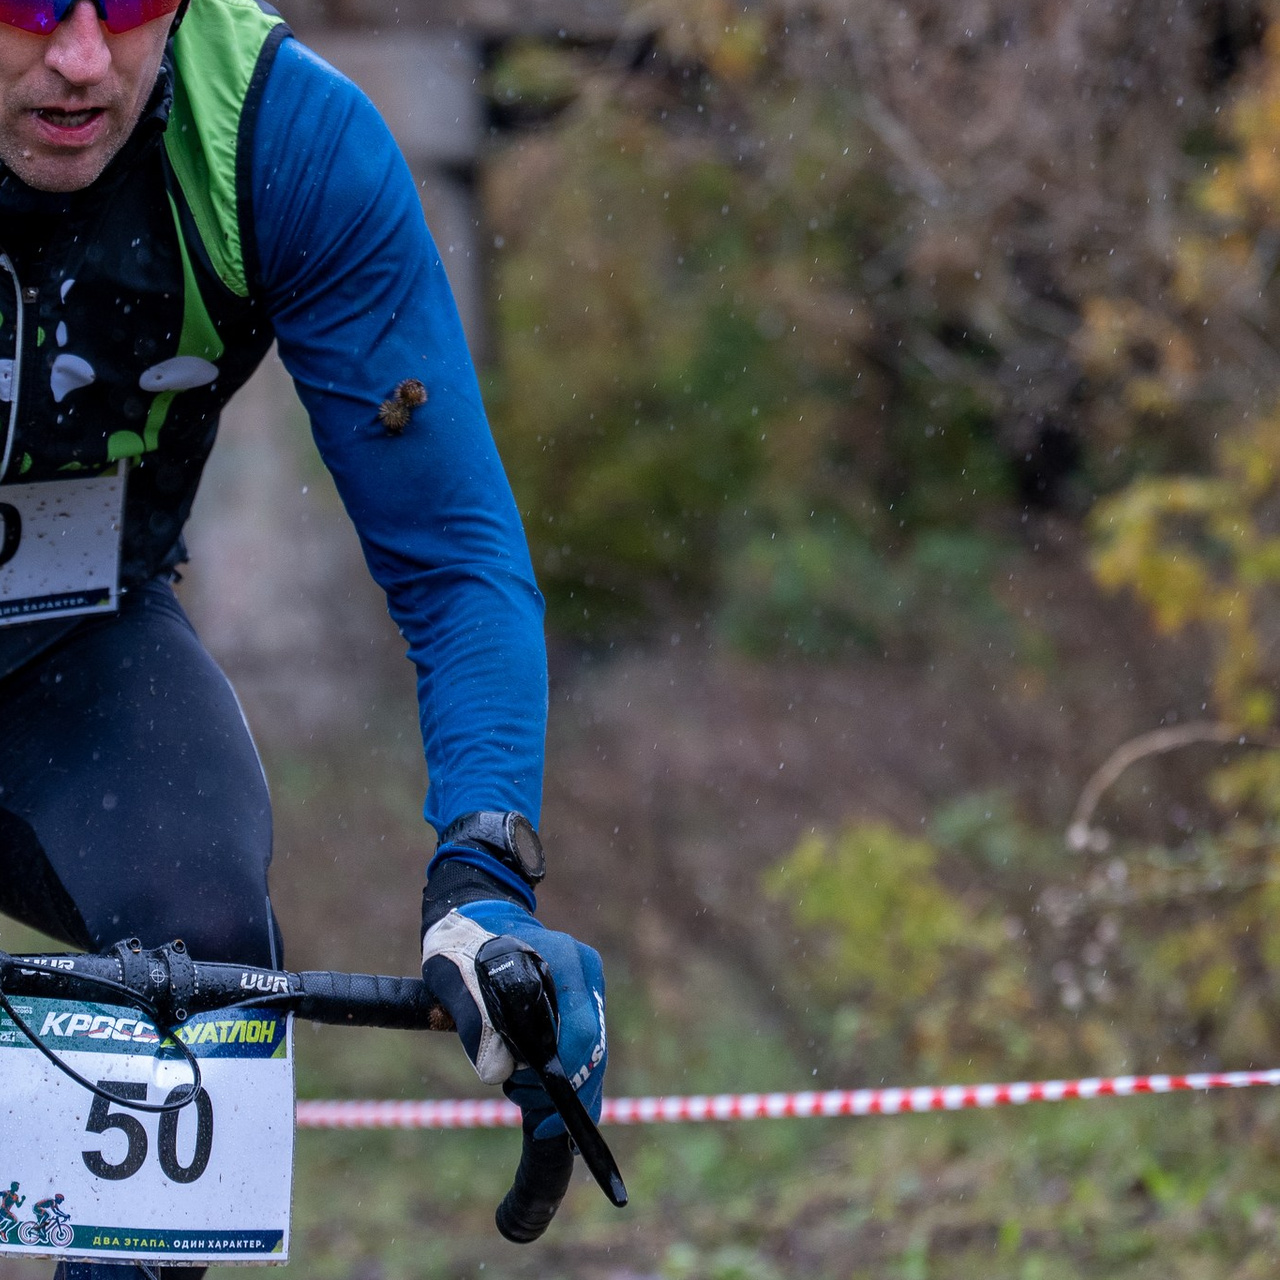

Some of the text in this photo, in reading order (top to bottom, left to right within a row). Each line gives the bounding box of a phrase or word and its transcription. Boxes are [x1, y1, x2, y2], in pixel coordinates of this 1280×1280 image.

[240, 972, 289, 994] UUR
[39, 1012, 160, 1044] КРОСС
[81, 1080, 214, 1184] 50
[93, 1236, 266, 1249] ДВА ЭТАПА. ОДИН ХАРАКТЕР.
